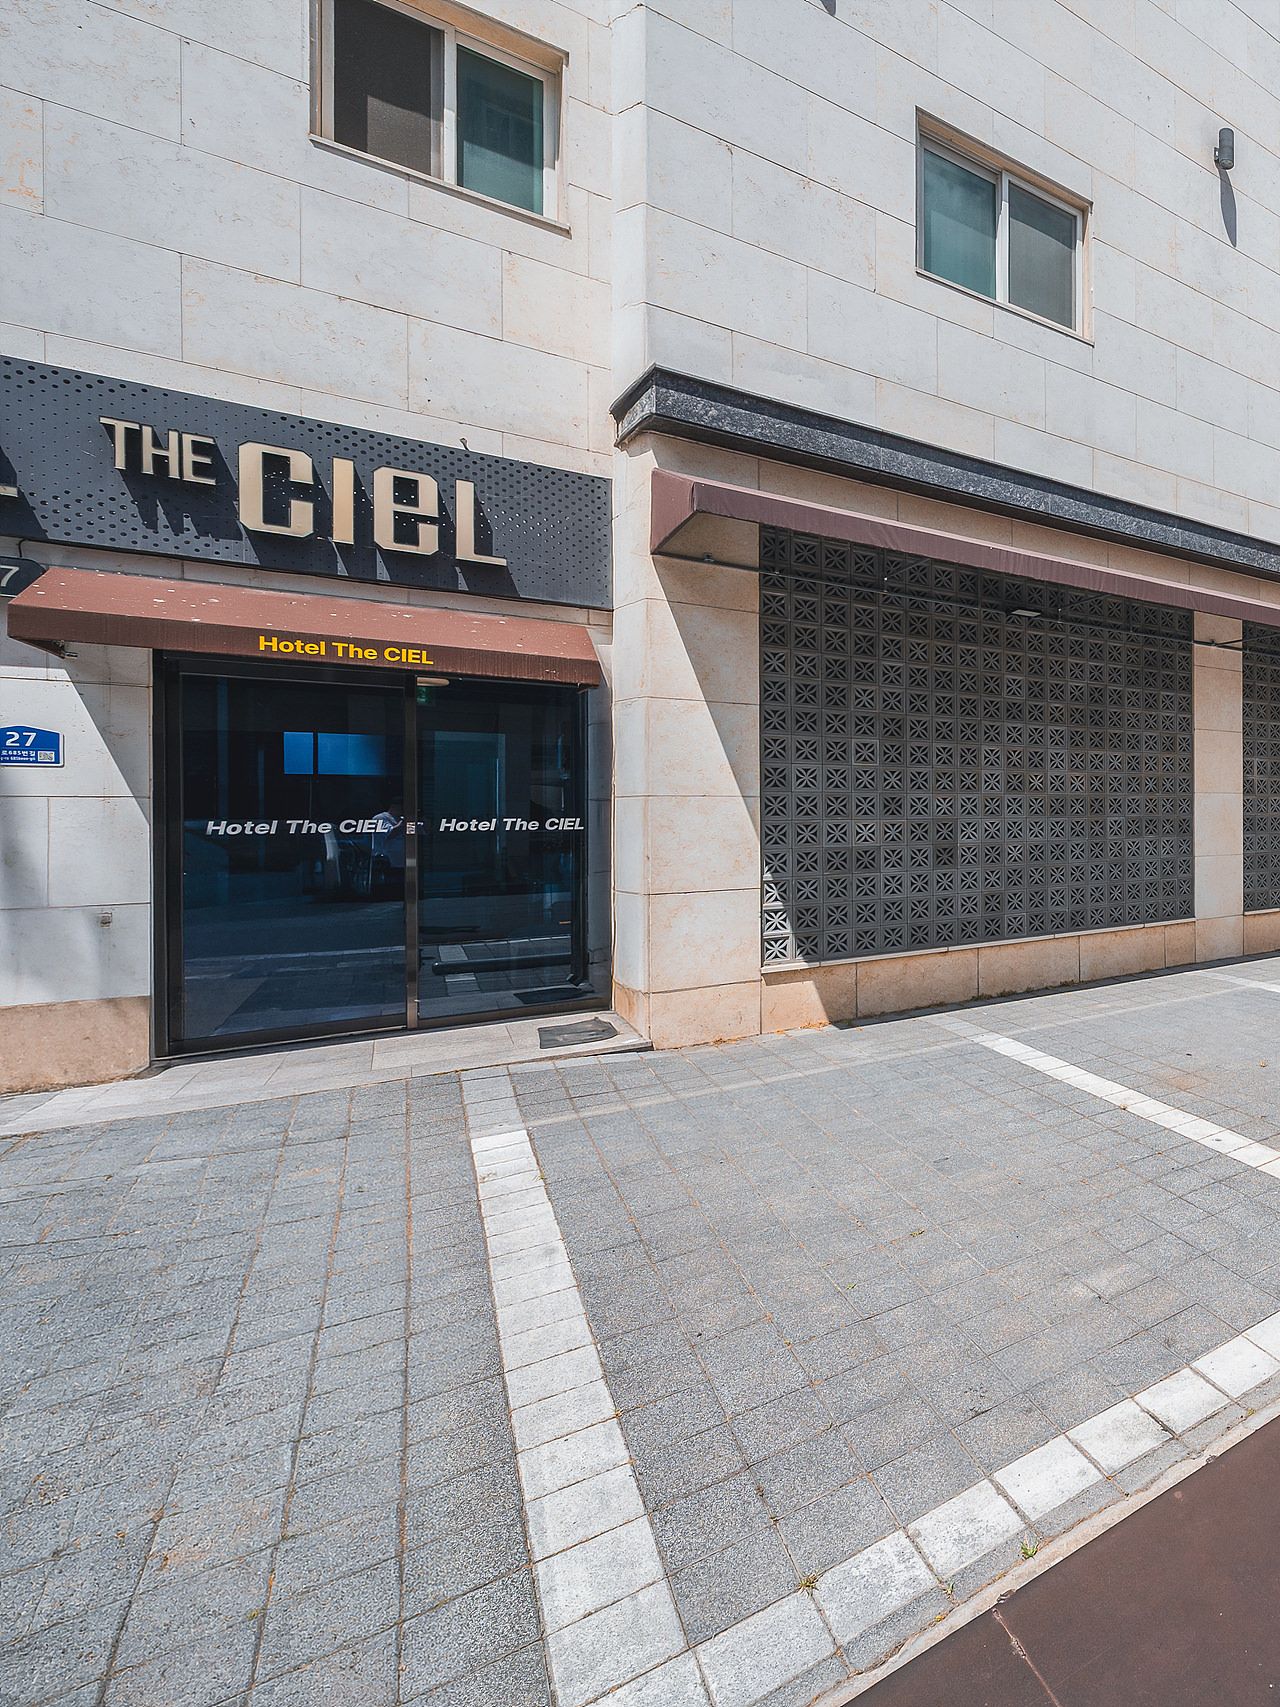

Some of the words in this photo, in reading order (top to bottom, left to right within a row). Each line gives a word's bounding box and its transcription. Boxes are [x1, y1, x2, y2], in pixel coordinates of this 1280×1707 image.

[100, 415, 216, 486] THE
[259, 635, 326, 656] Hotel
[332, 642, 378, 660] The
[383, 647, 434, 665] CIEL
[5, 731, 37, 747] 27
[205, 819, 278, 836] Hotel
[286, 820, 332, 835] The
[339, 819, 391, 834] CIEL
[439, 818, 497, 832] Hotel
[502, 818, 543, 832] The
[544, 818, 585, 831] CIEL
